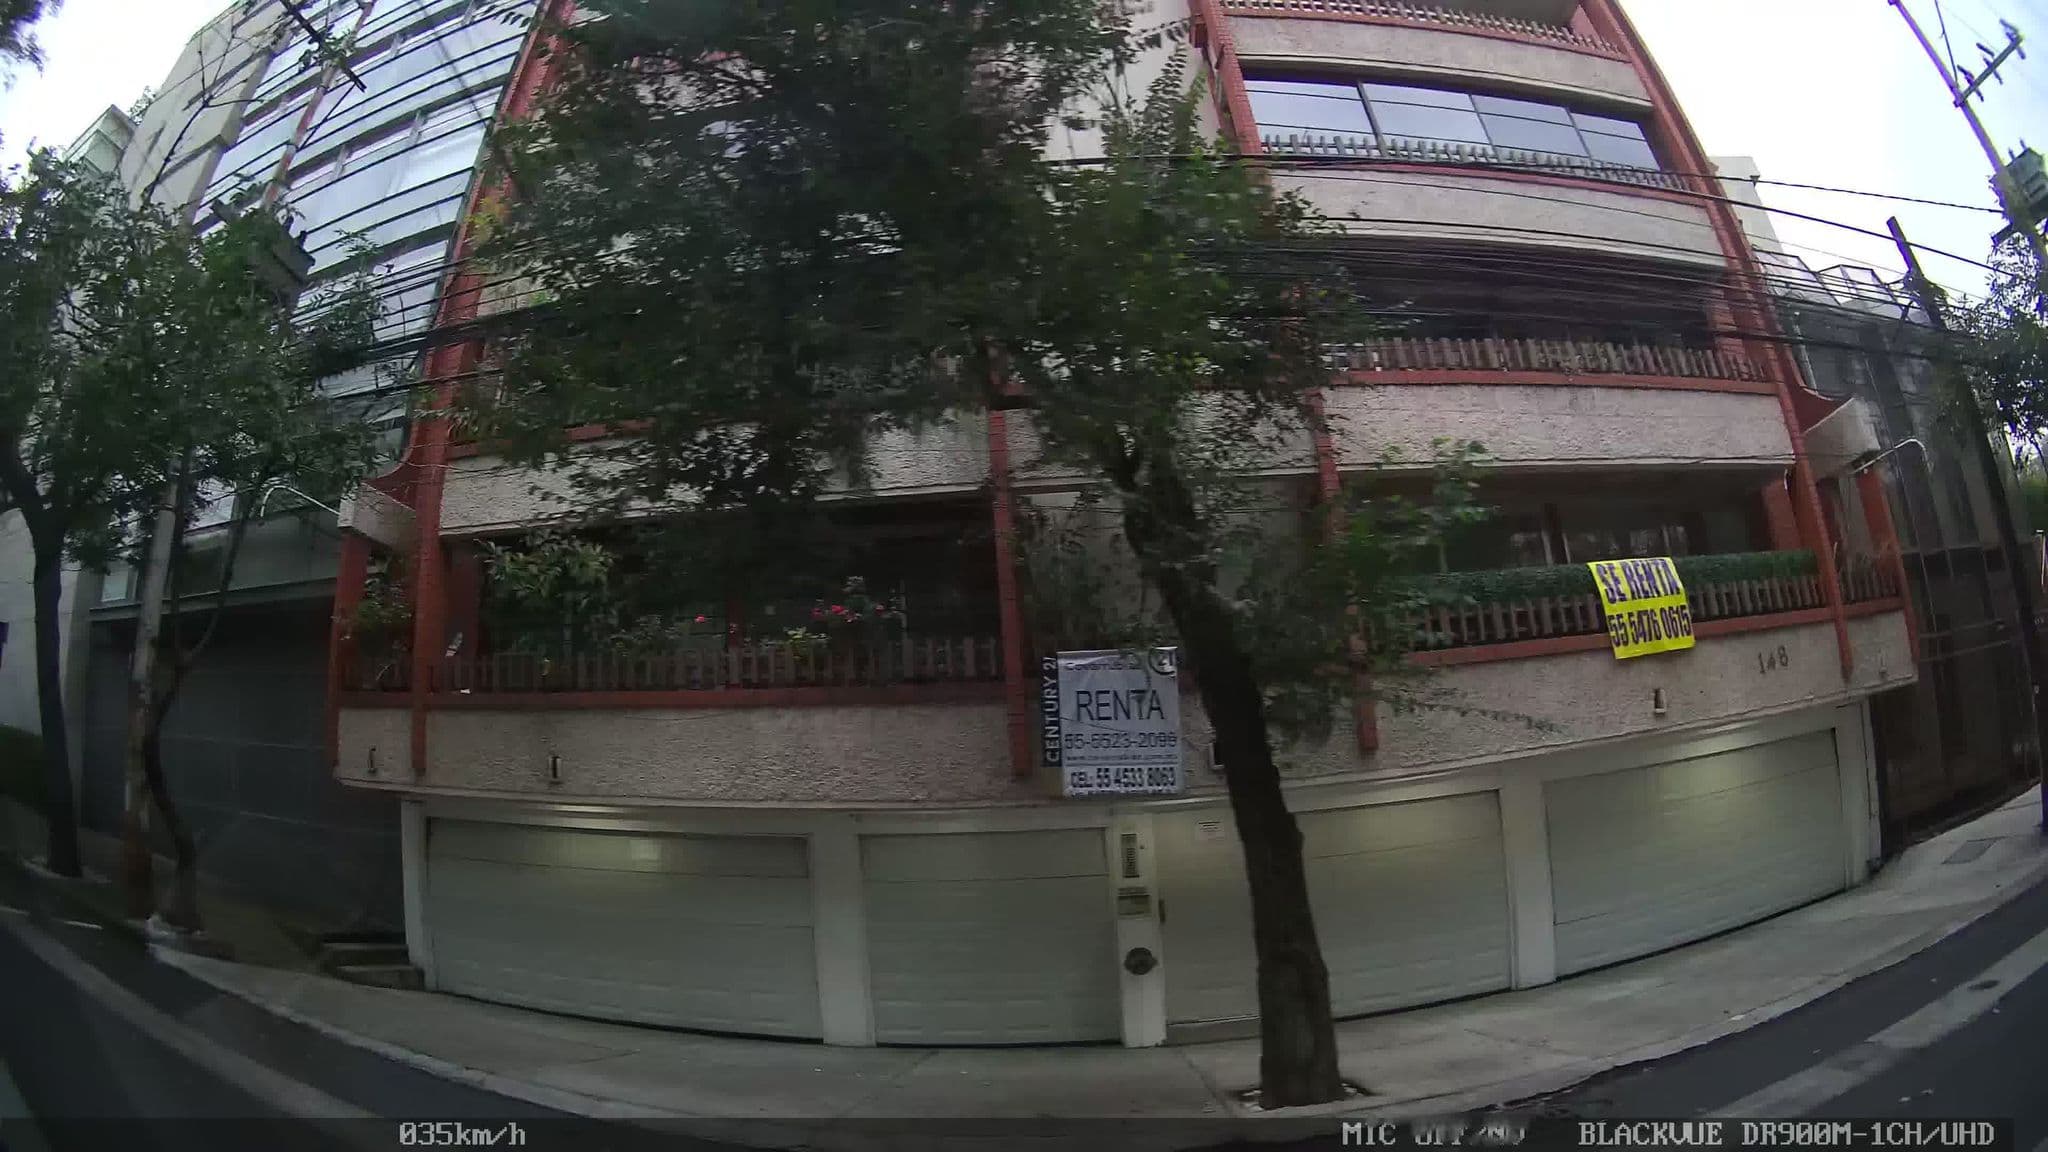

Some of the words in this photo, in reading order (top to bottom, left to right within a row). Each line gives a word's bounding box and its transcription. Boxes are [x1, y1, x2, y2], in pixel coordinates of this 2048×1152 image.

[1596, 562, 1627, 604] SE
[1620, 559, 1681, 600] RENTA
[1608, 613, 1630, 647] 55
[1627, 608, 1662, 644] 5476
[1660, 604, 1692, 639] 0615
[1043, 656, 1057, 670] 21
[1043, 675, 1060, 762] CENTURY
[1075, 689, 1165, 721] RENTA
[1096, 767, 1111, 788] 55
